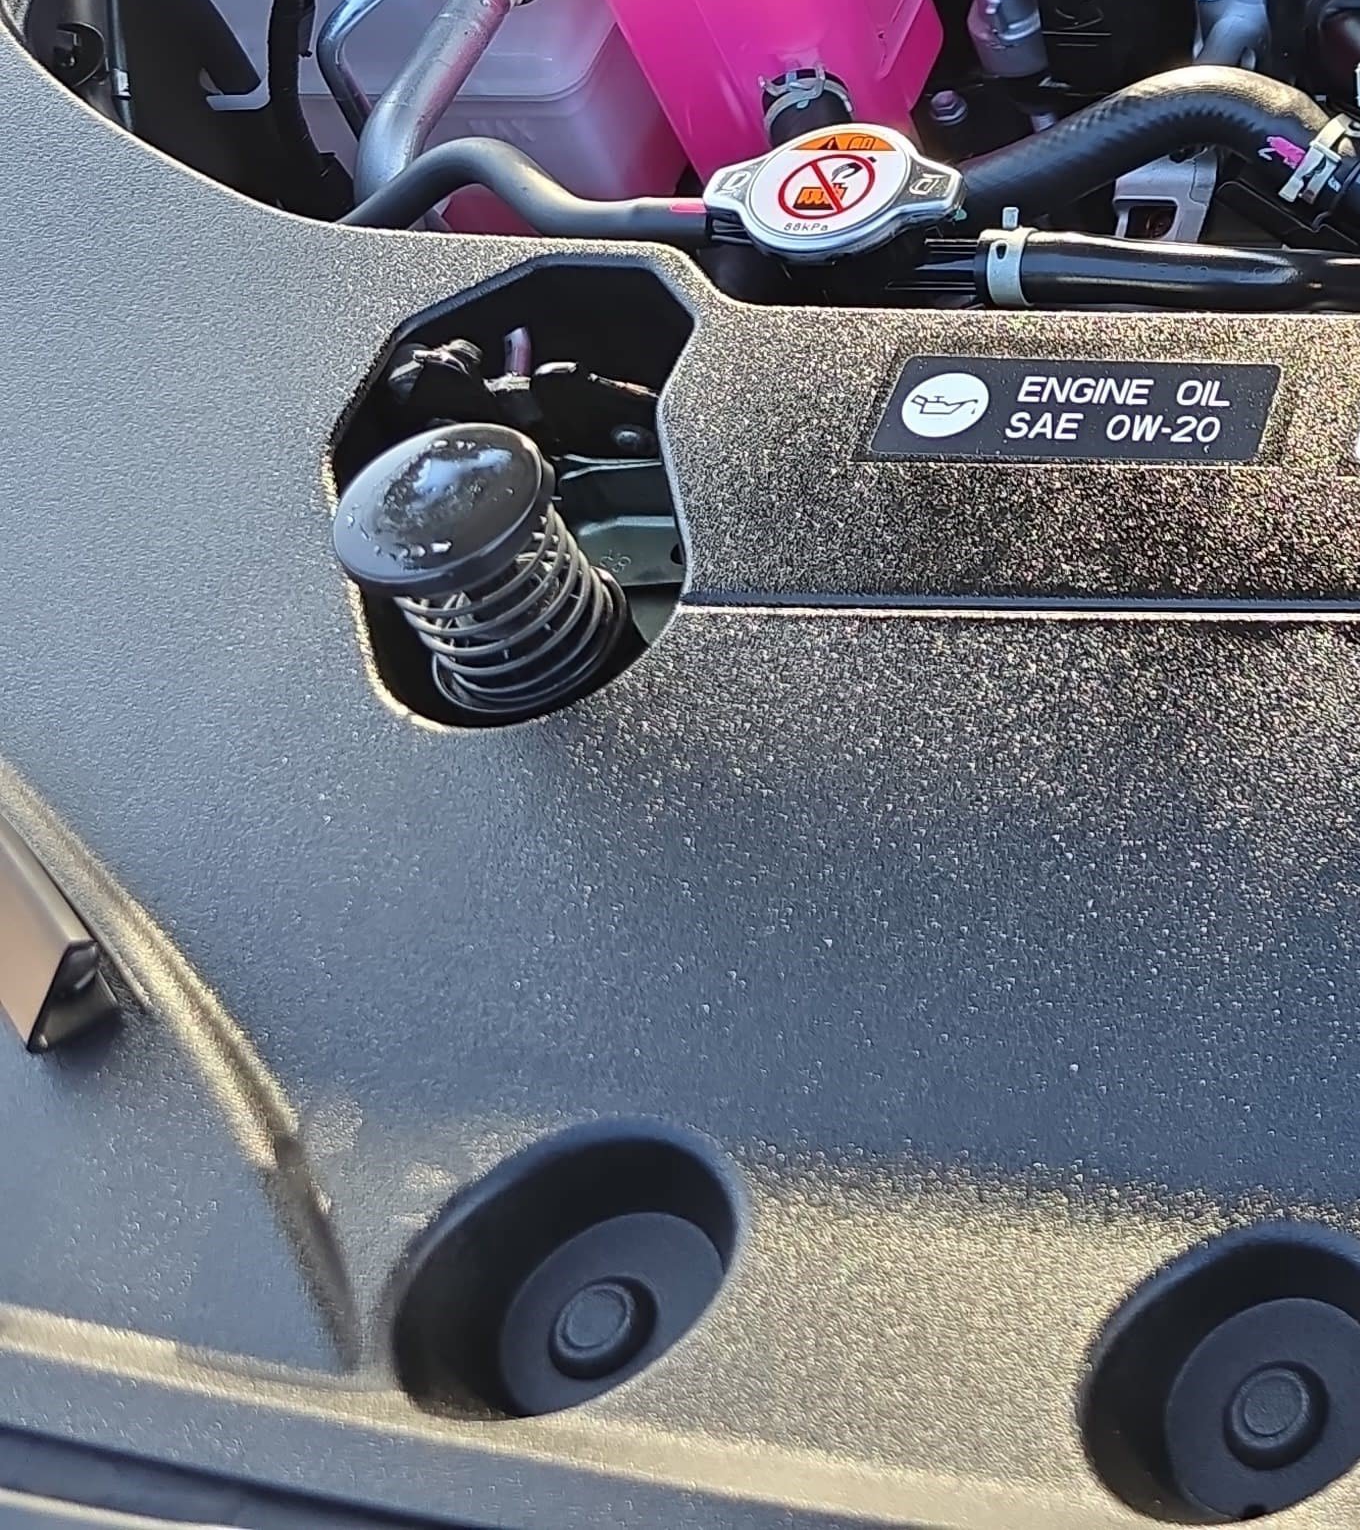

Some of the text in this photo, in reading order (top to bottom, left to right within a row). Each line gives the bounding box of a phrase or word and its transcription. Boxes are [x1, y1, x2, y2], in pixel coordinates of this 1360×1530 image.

[783, 221, 829, 232] 88kPa
[1017, 376, 1231, 407] ENGINE OIL
[1004, 411, 1221, 444] SAE 0W-20
